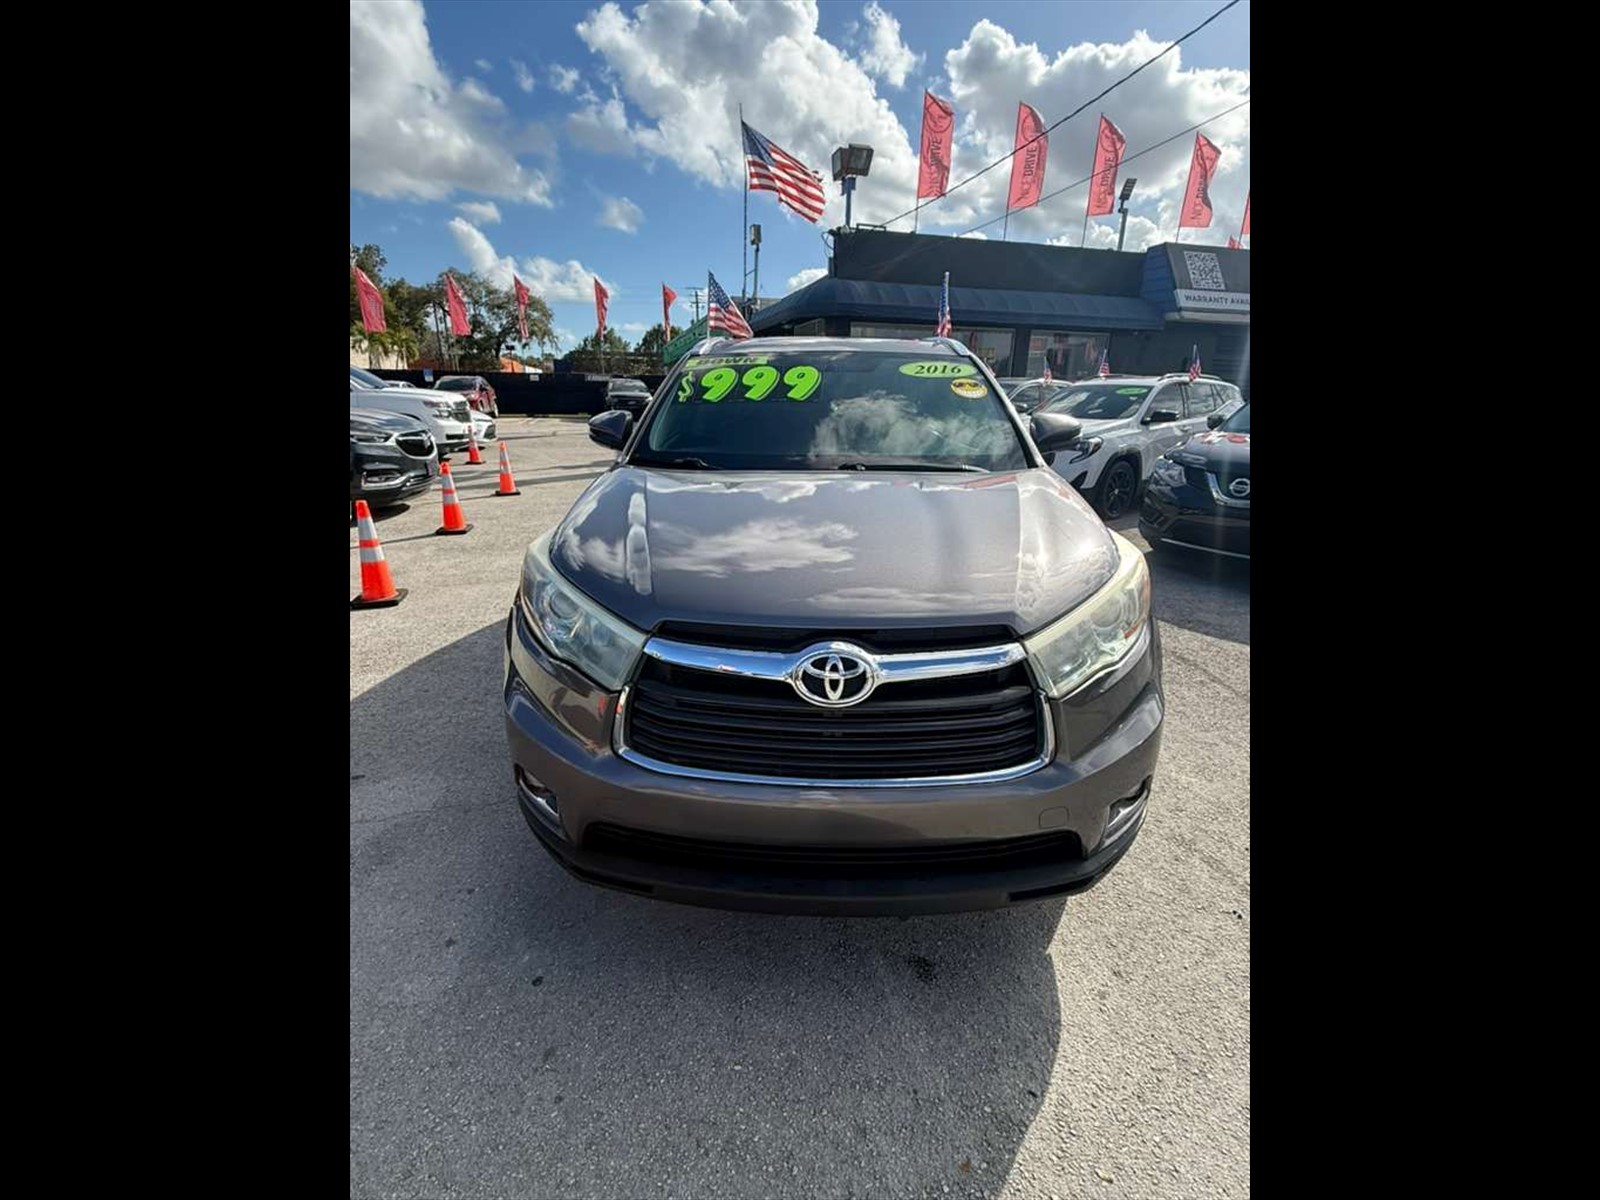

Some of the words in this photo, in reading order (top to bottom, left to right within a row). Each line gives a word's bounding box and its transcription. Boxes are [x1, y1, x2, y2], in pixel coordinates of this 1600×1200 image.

[1024, 145, 1037, 177] DRIVE
[1101, 156, 1115, 186] DRIVE
[1184, 294, 1229, 304] WARRANTY
[678, 366, 822, 402] $999
[914, 364, 963, 375] 2016
